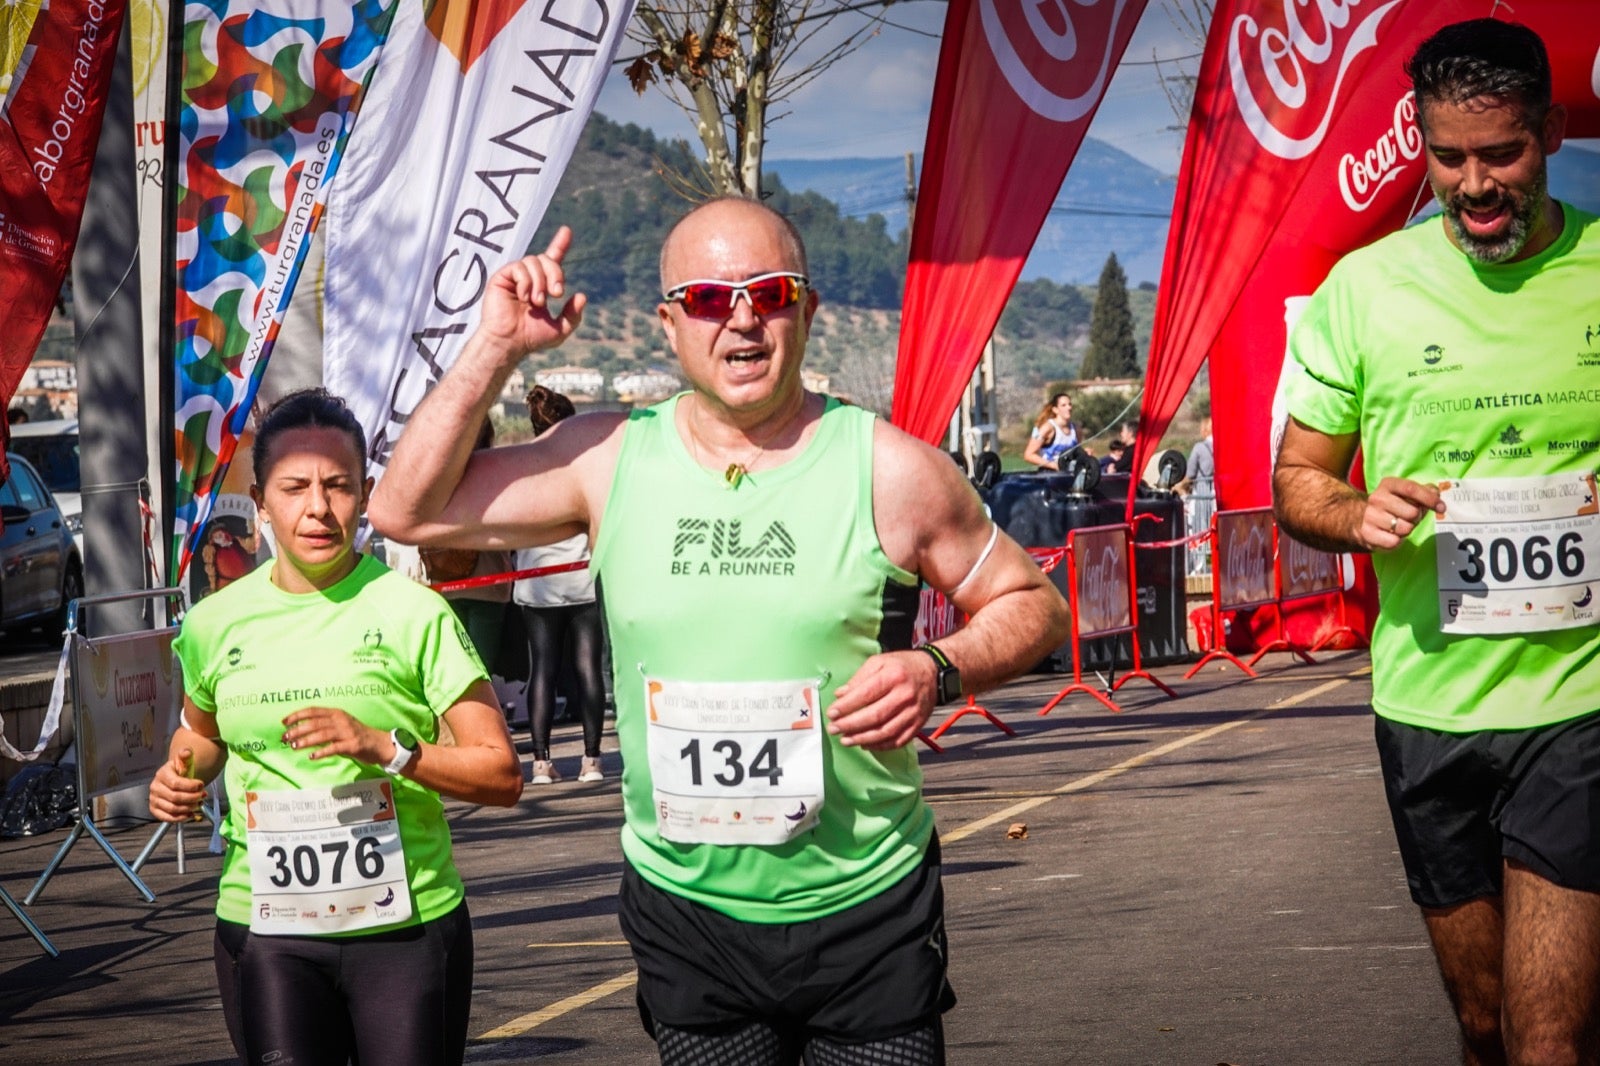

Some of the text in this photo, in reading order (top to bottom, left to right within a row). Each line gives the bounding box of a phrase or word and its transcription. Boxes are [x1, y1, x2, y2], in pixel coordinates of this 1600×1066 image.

[5, 234, 16, 244] de
[18, 238, 54, 257] Granada
[8, 223, 54, 246] Diputación
[247, 127, 335, 362] www.turgranada.es
[1412, 398, 1472, 419] JUVENTUD
[1474, 393, 1543, 410] ATLÉTICA
[674, 518, 796, 558] FILA
[671, 561, 795, 576] BE A RUNNER
[1457, 531, 1585, 584] 3066
[260, 687, 321, 704] ATLÉTICA
[325, 682, 393, 698] MARACENA
[680, 738, 784, 787] 134
[266, 836, 385, 888] 3076
